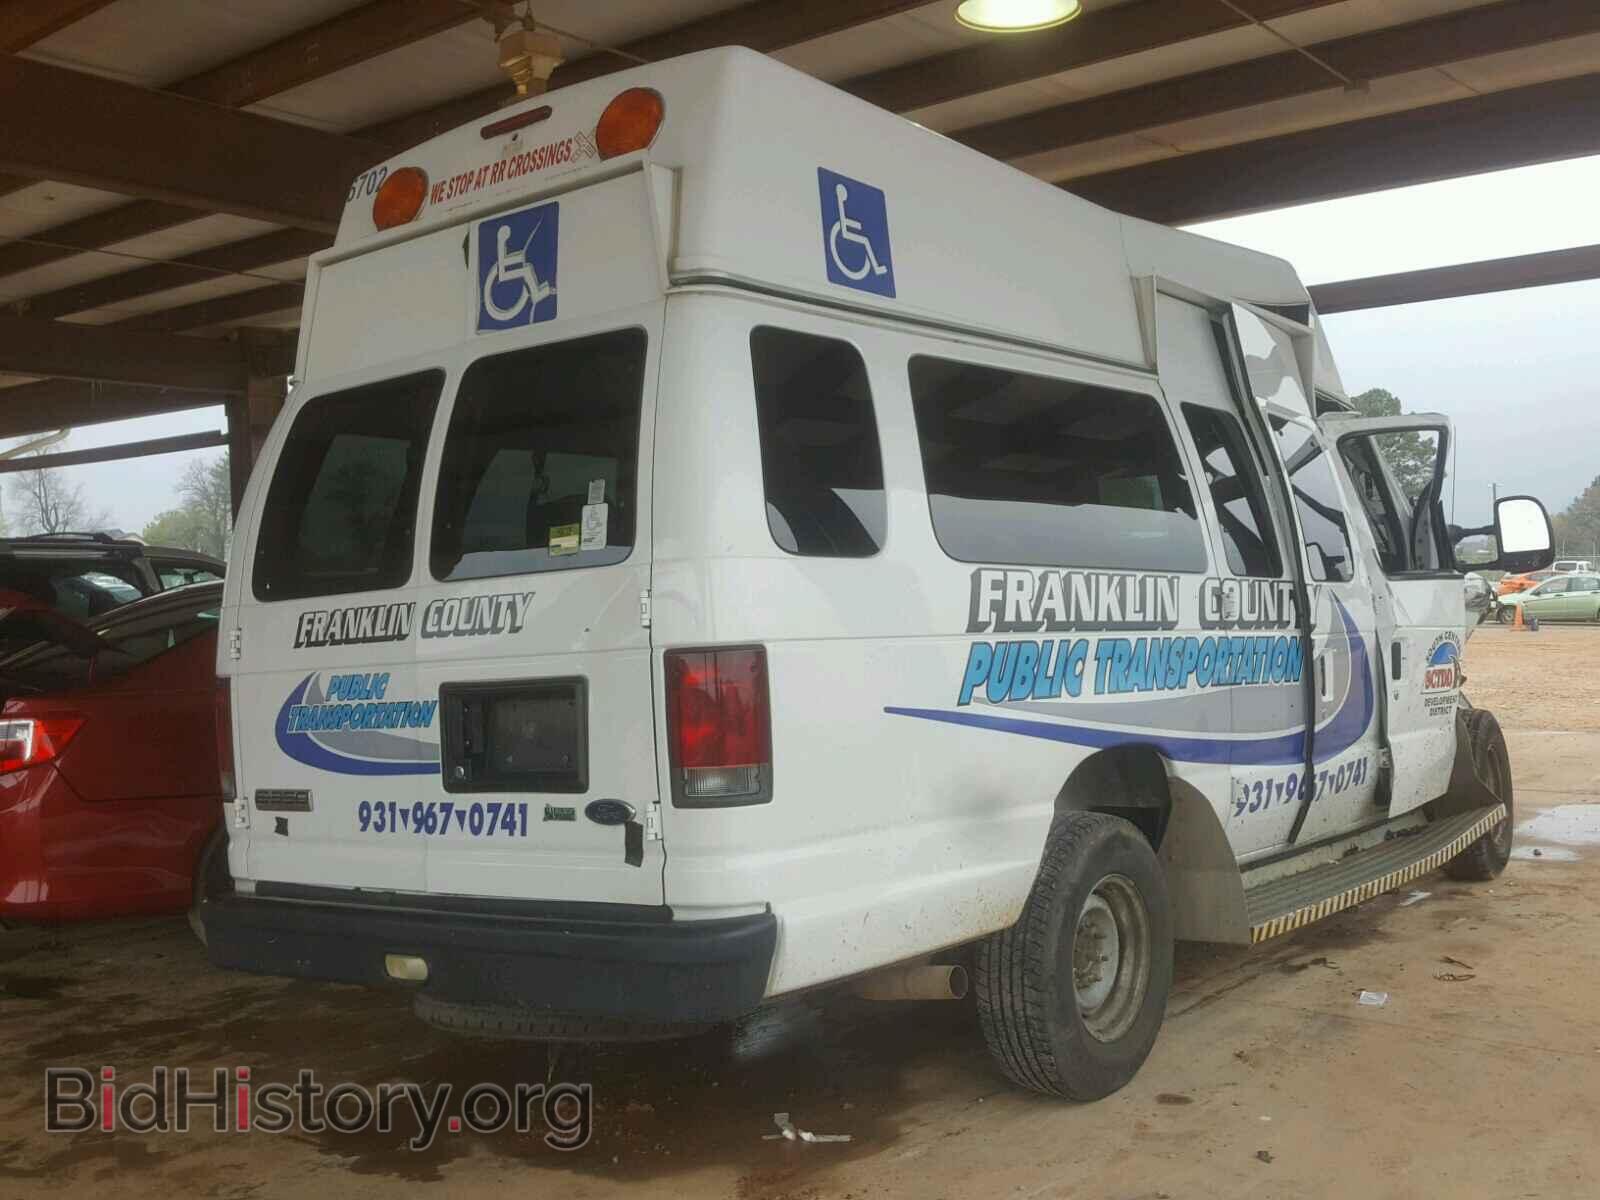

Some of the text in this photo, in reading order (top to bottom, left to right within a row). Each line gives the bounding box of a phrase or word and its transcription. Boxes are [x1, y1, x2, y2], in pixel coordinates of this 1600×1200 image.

[429, 180, 447, 206] WE
[446, 170, 475, 200] STOP
[473, 164, 490, 190] AT
[489, 160, 507, 186] RR
[507, 137, 573, 180] CROSSINGS
[293, 592, 536, 648] FRANKLIN COUNTY
[966, 568, 1180, 633] FRANKLIN
[957, 635, 1303, 707] PUBLIC TRANSPORTATION
[286, 672, 439, 734] PUBLIC TRANSPORTATION
[1334, 757, 1368, 794] 0741
[358, 800, 397, 833] 931
[411, 801, 454, 835] 967
[468, 802, 528, 837] 0741
